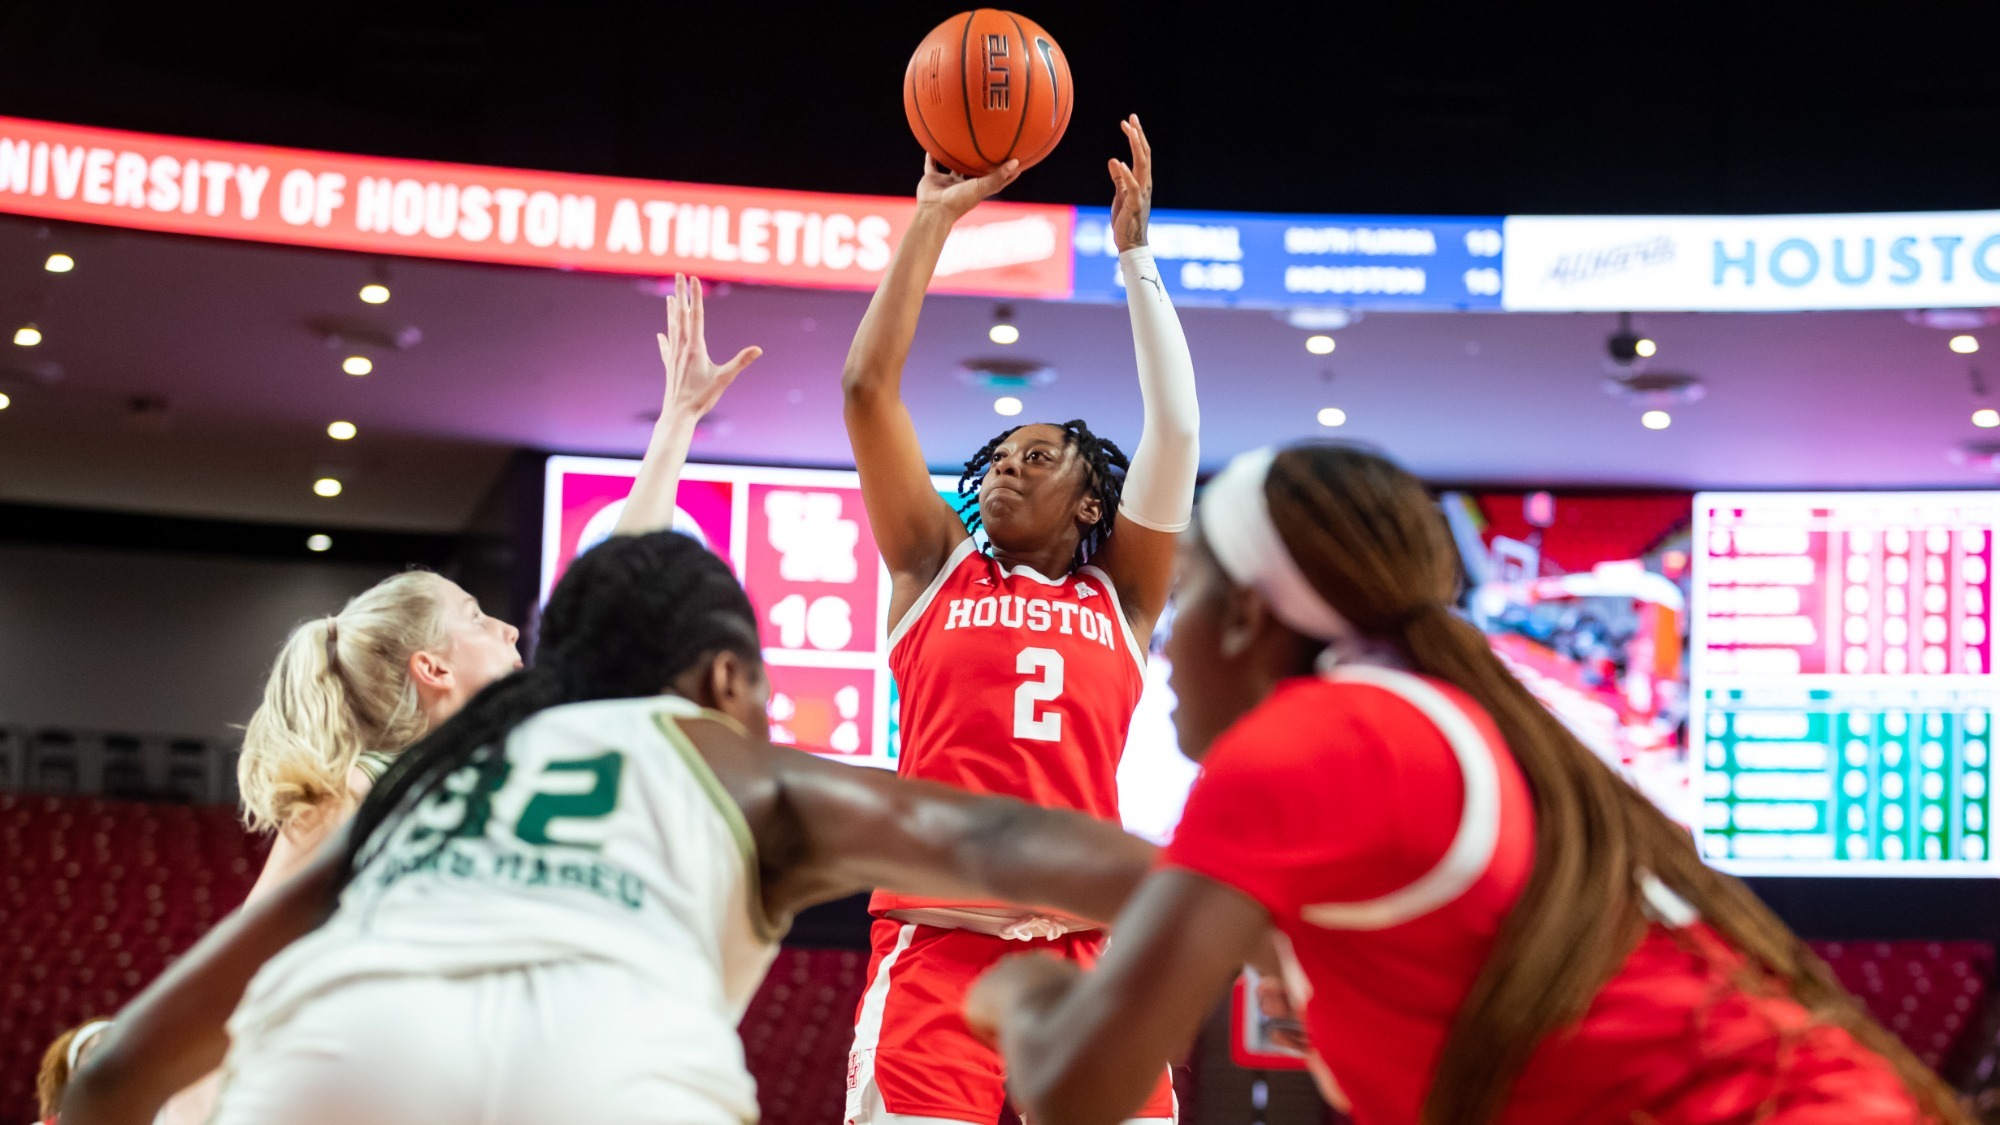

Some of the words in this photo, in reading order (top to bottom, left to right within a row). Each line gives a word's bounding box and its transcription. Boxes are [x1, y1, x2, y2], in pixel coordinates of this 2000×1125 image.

[987, 34, 1011, 111] ELITE
[0, 138, 269, 220] NIVERSITY
[279, 168, 346, 228] OF
[356, 175, 596, 251] HOUSTON
[606, 197, 891, 271] ATHLETICS
[769, 593, 853, 651] 16
[943, 594, 1116, 651] HOUSTON
[1013, 646, 1064, 743] 2
